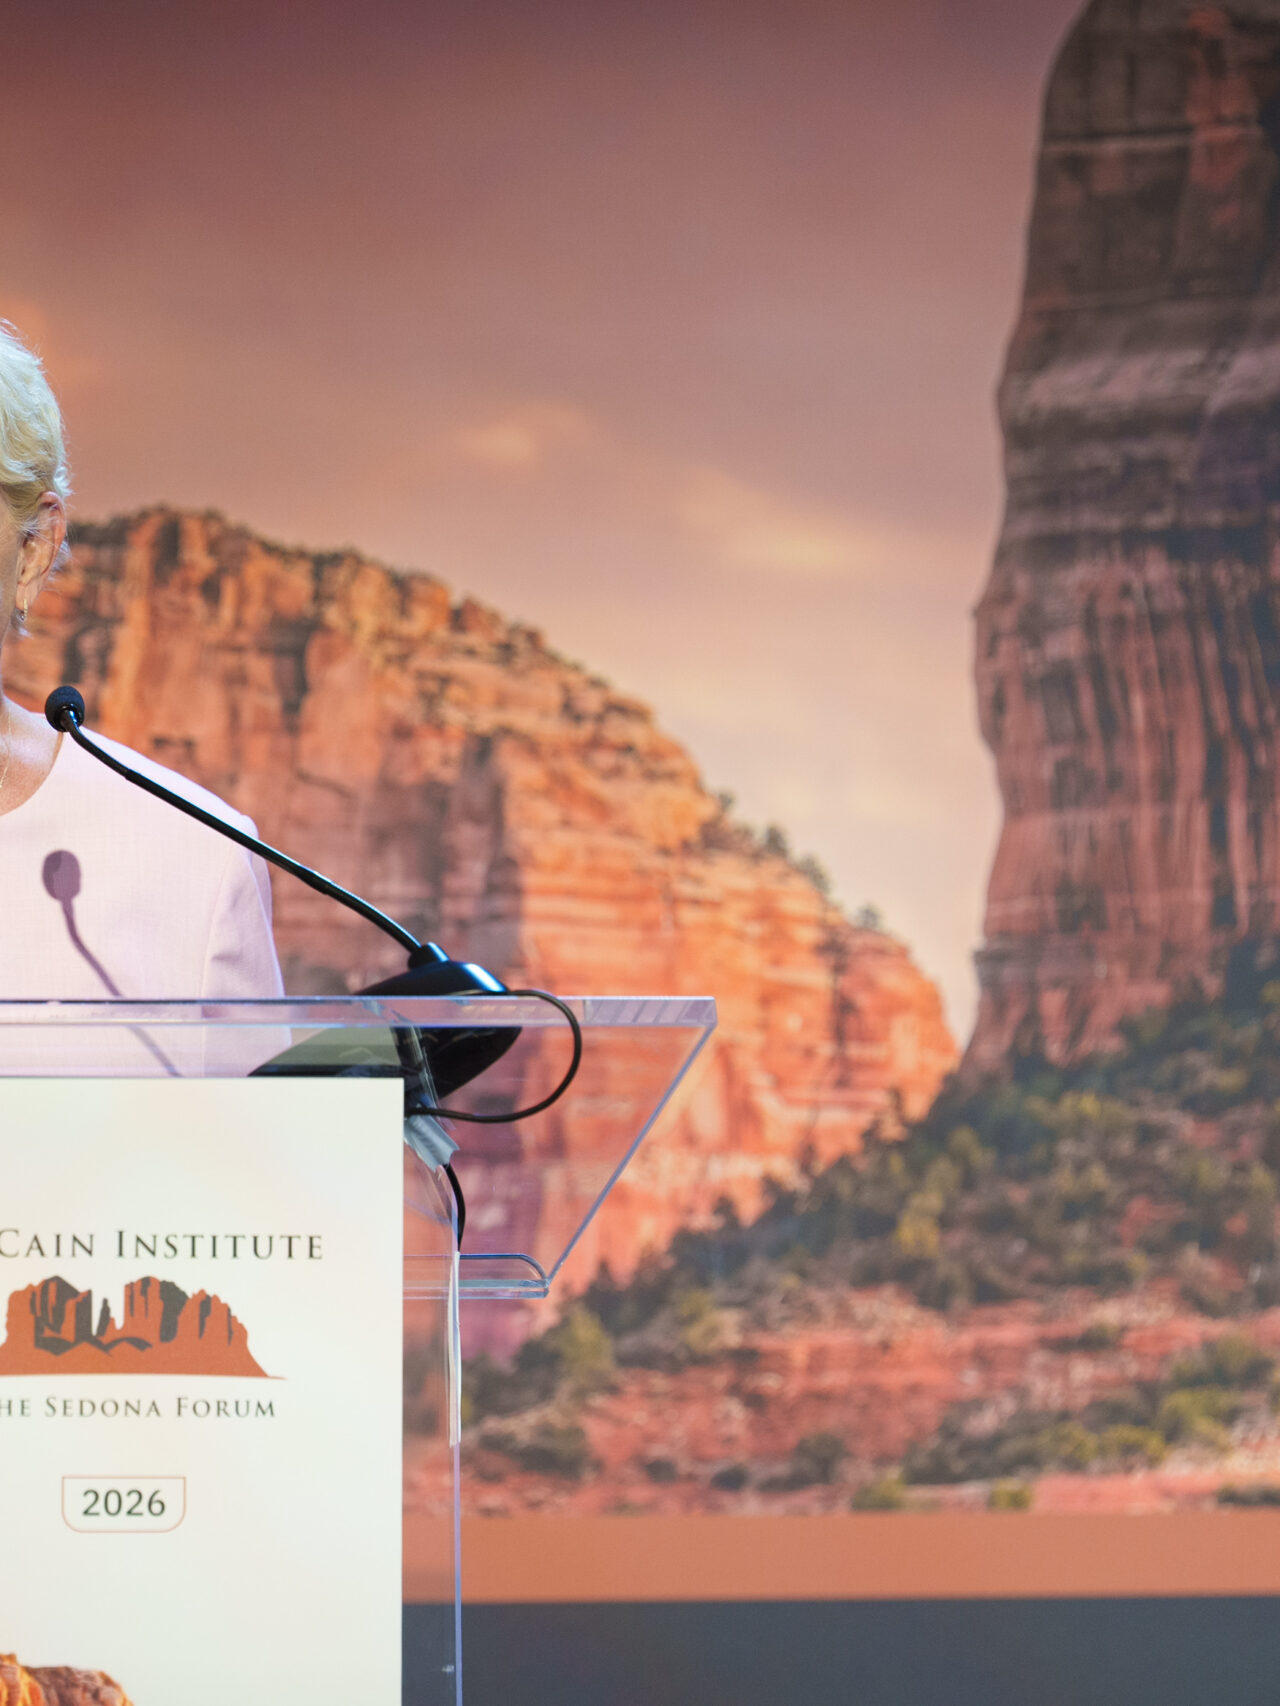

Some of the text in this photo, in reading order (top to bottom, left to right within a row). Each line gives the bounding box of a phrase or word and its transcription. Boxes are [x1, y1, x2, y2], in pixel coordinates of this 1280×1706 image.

[117, 1229, 324, 1260] INSTITUTE
[45, 1396, 162, 1417] SEDONA
[176, 1396, 276, 1418] FORUM
[82, 1489, 167, 1517] 2026
